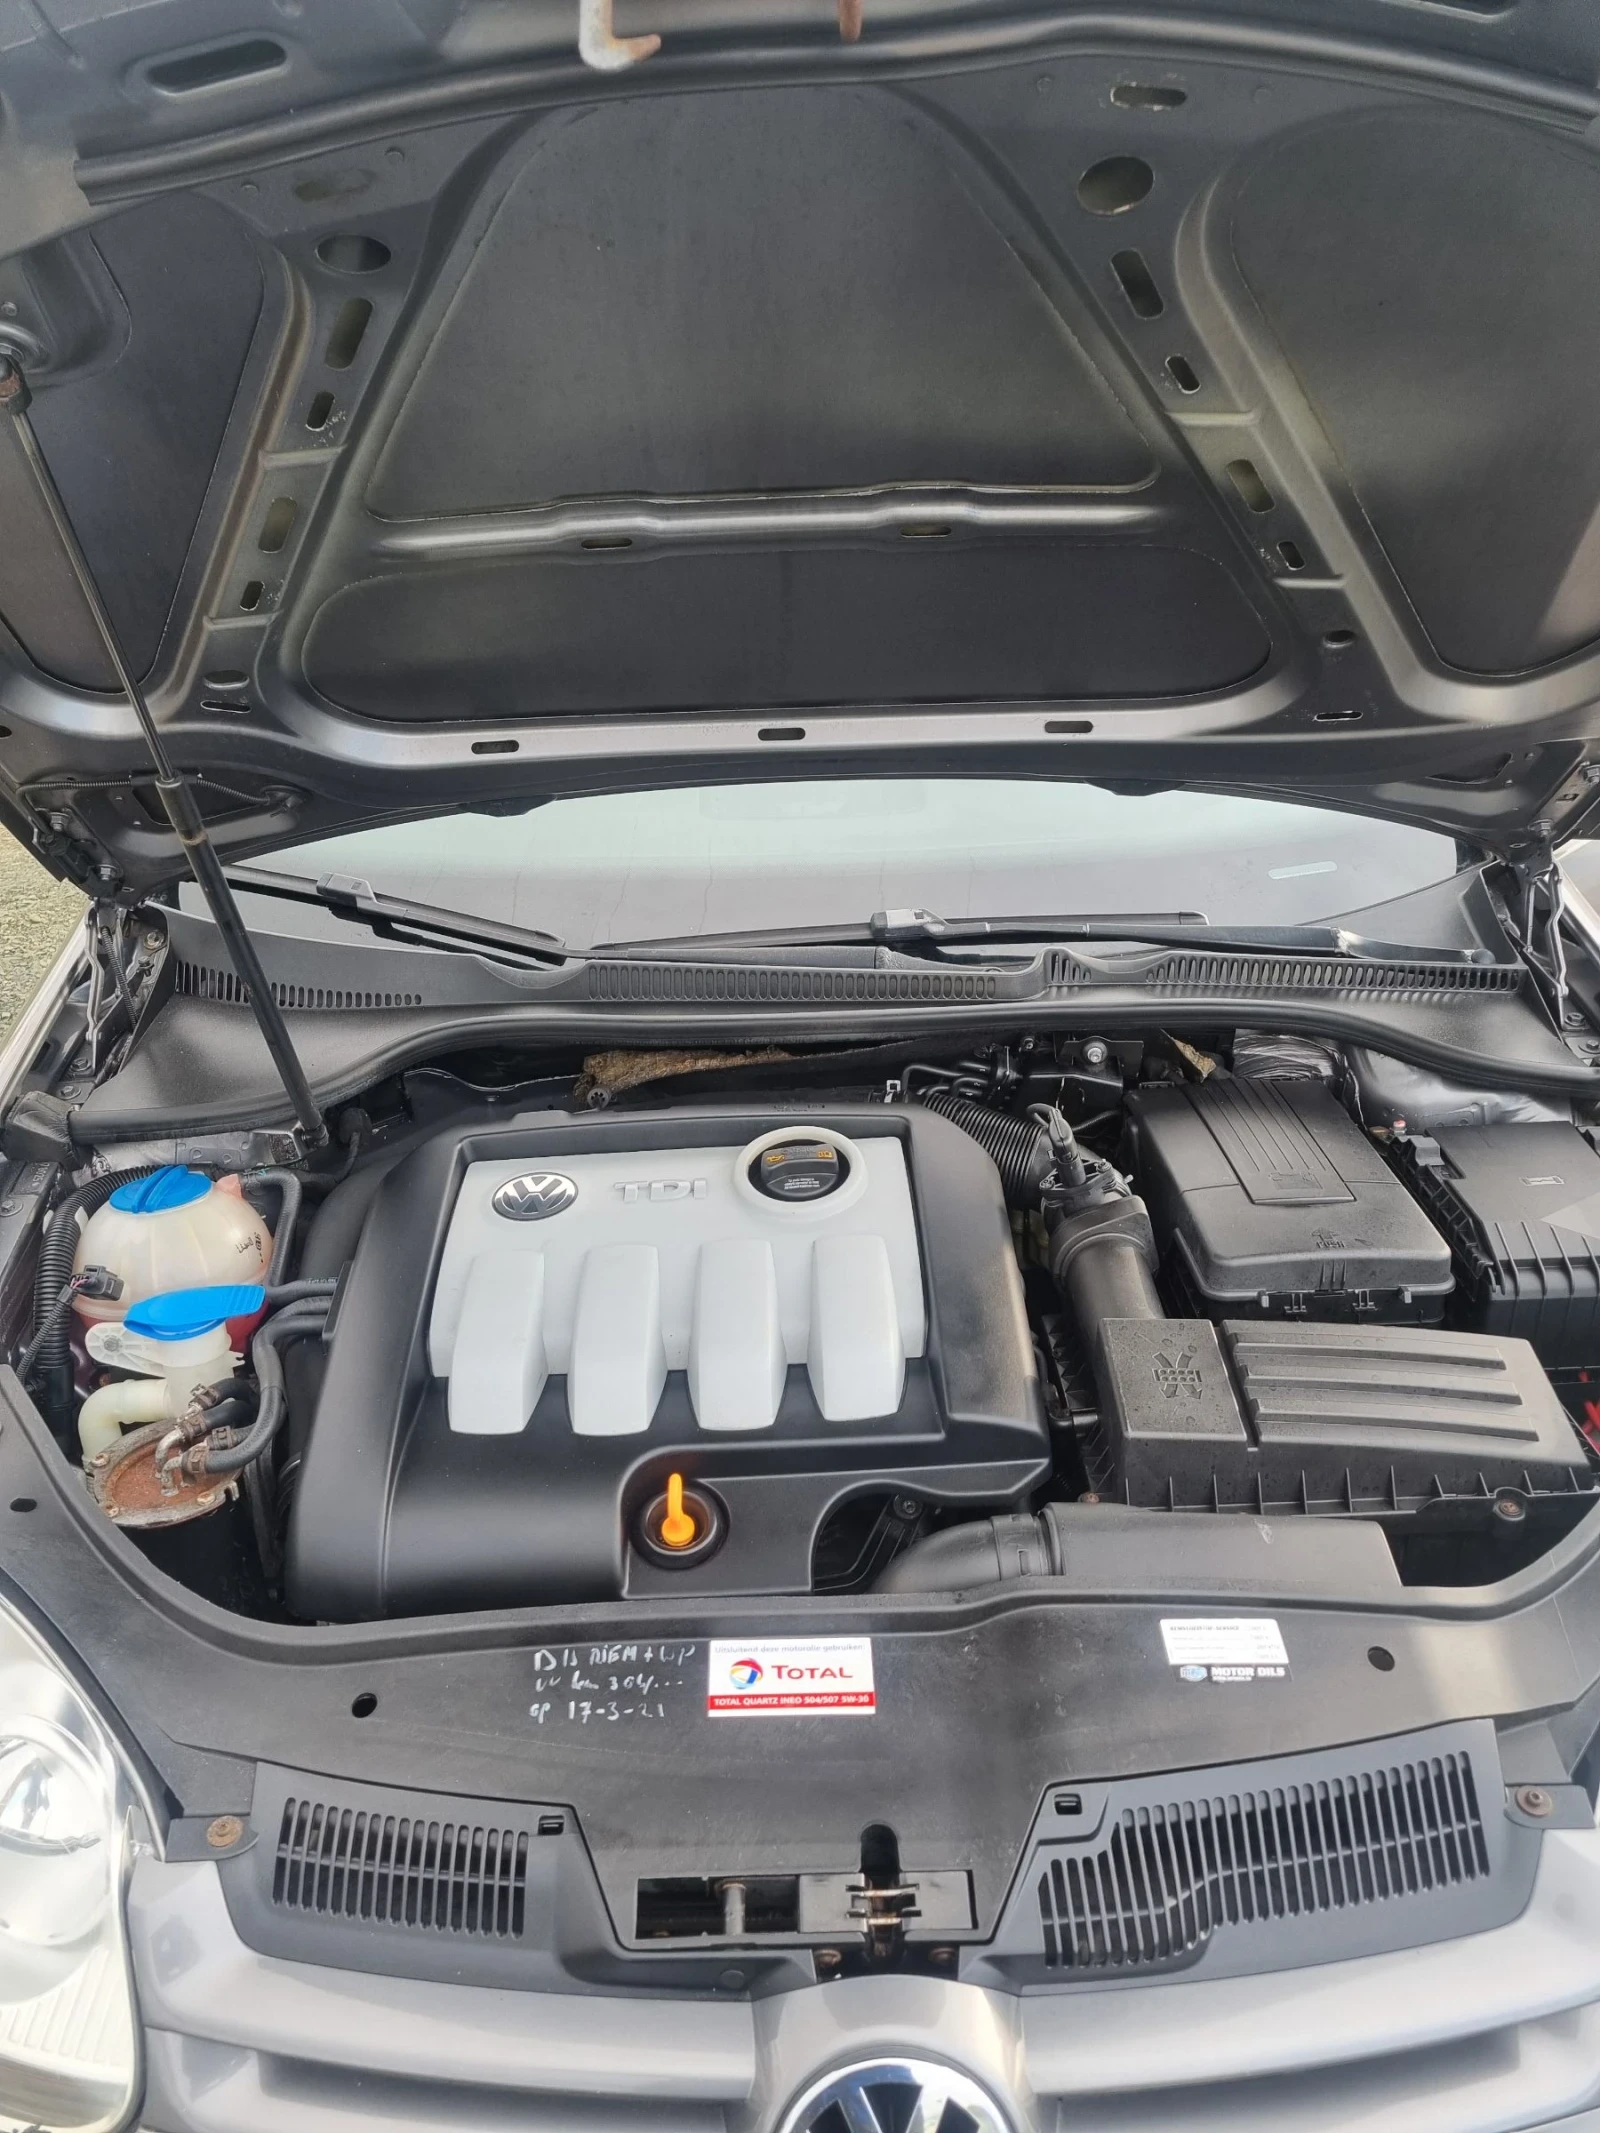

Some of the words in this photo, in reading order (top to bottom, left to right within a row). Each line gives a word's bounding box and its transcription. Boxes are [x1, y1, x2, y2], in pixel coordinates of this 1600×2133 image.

[613, 1177, 707, 1203] TDI
[760, 1645, 779, 1653] deze
[771, 1664, 853, 1680] TOTAL
[1211, 1667, 1254, 1676] MOTOR
[1257, 1667, 1285, 1677] OILS
[714, 1697, 741, 1706] TOTAL
[743, 1697, 779, 1706] QUARTZ
[780, 1696, 802, 1705] INEO
[804, 1695, 838, 1704] 504/507
[841, 1694, 869, 1703] 5W-30
